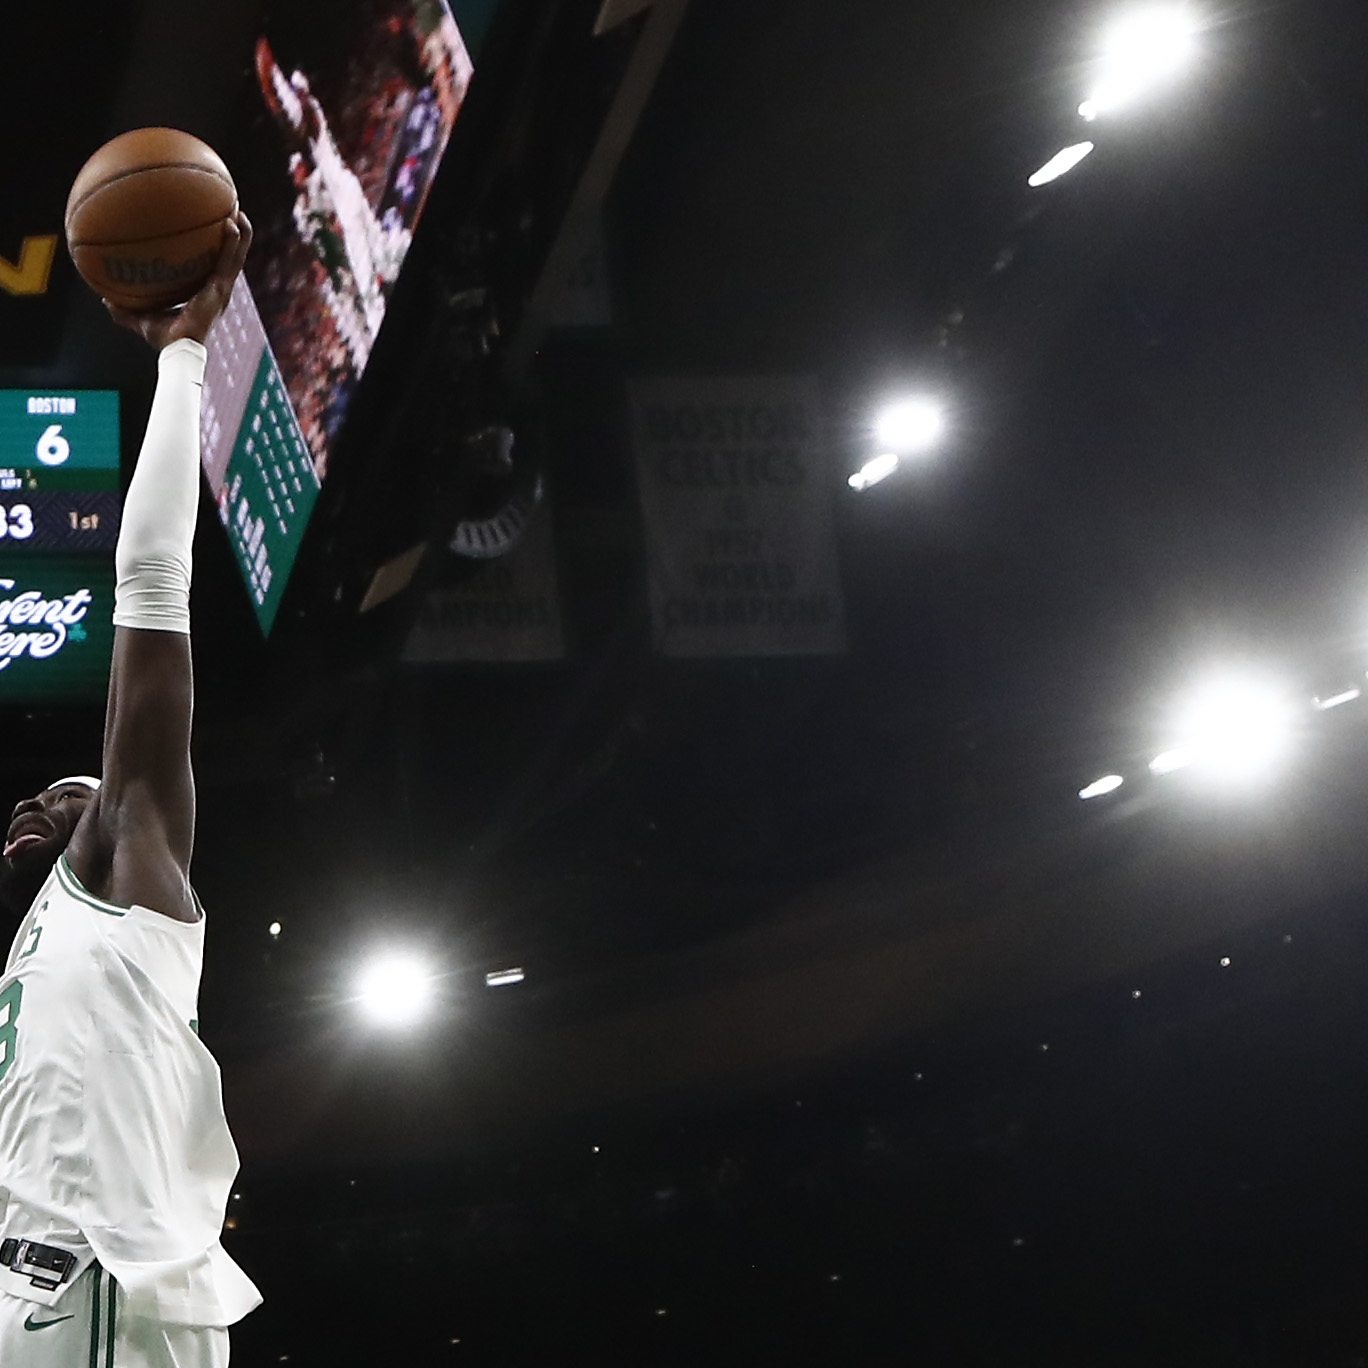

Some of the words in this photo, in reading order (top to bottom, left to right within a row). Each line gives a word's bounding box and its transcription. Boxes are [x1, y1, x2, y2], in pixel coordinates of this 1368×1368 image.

[27, 396, 76, 415] BOSTON
[35, 424, 70, 466] 6
[68, 511, 100, 530] 1st
